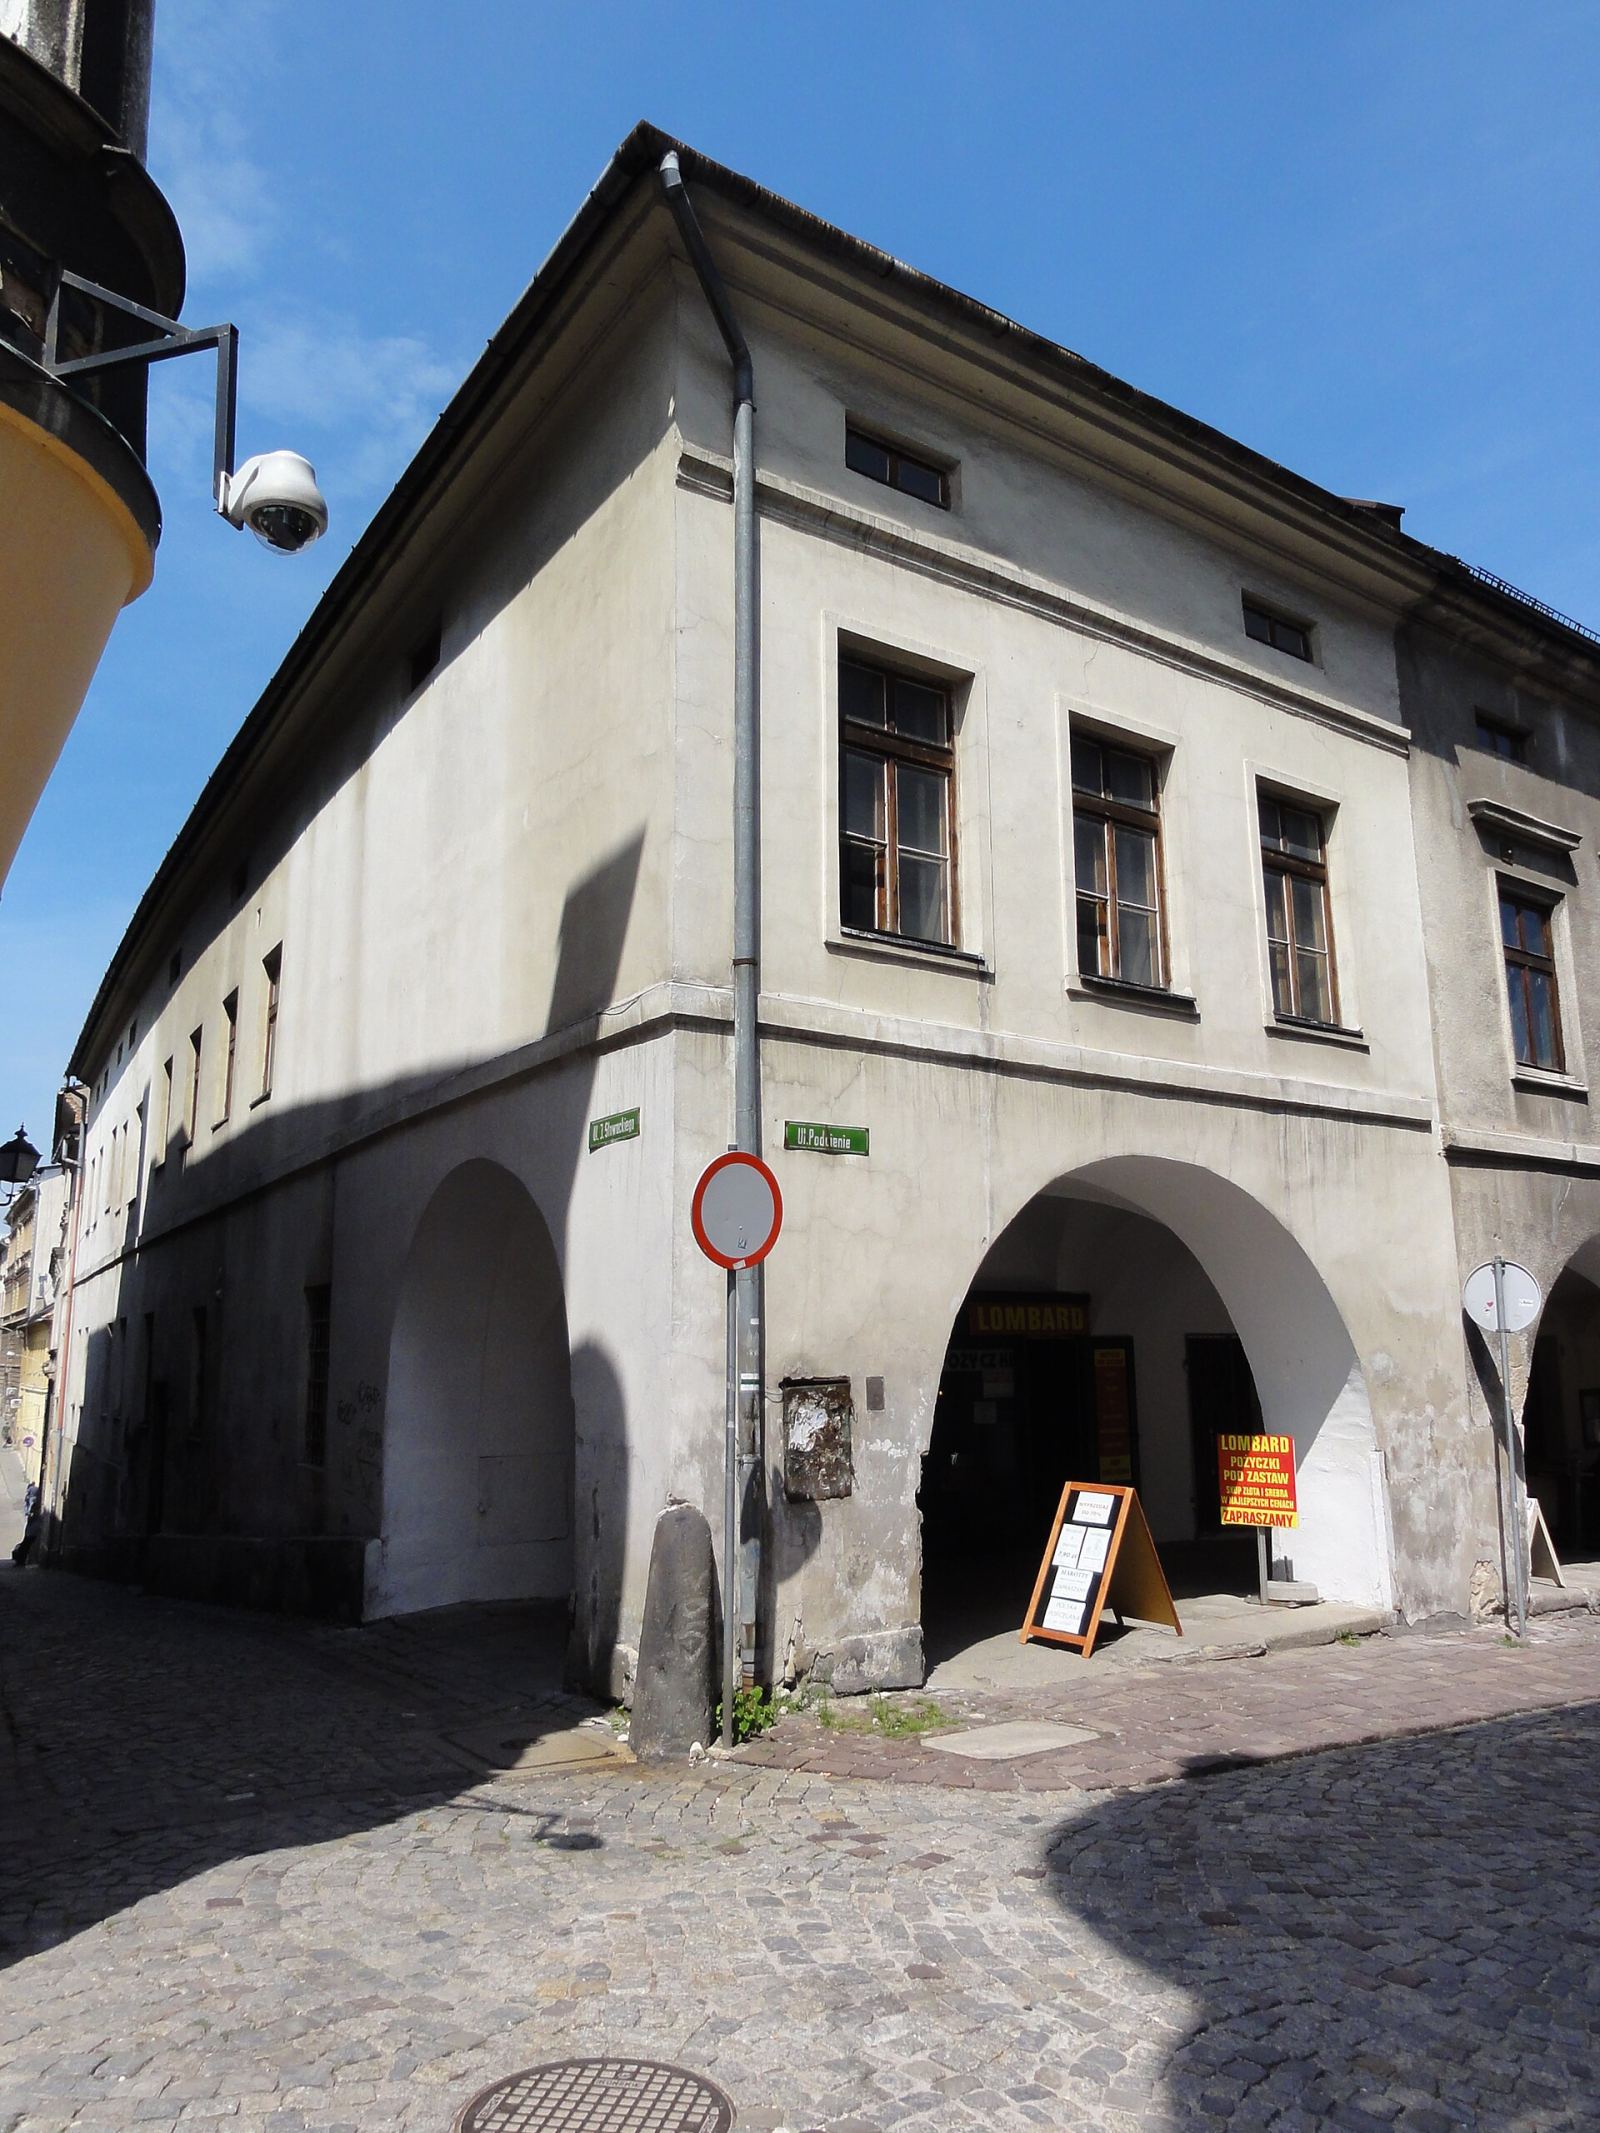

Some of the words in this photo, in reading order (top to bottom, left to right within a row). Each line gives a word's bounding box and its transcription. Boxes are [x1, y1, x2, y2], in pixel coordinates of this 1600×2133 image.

[976, 1305, 1084, 1331] LOMBARD
[1221, 1435, 1289, 1453] LOMBARD
[1230, 1454, 1280, 1470] POŻYCZKI
[1223, 1469, 1244, 1482] POD
[1246, 1471, 1289, 1484] ZASTAW
[1223, 1510, 1293, 1528] ZAPRASZAMY
